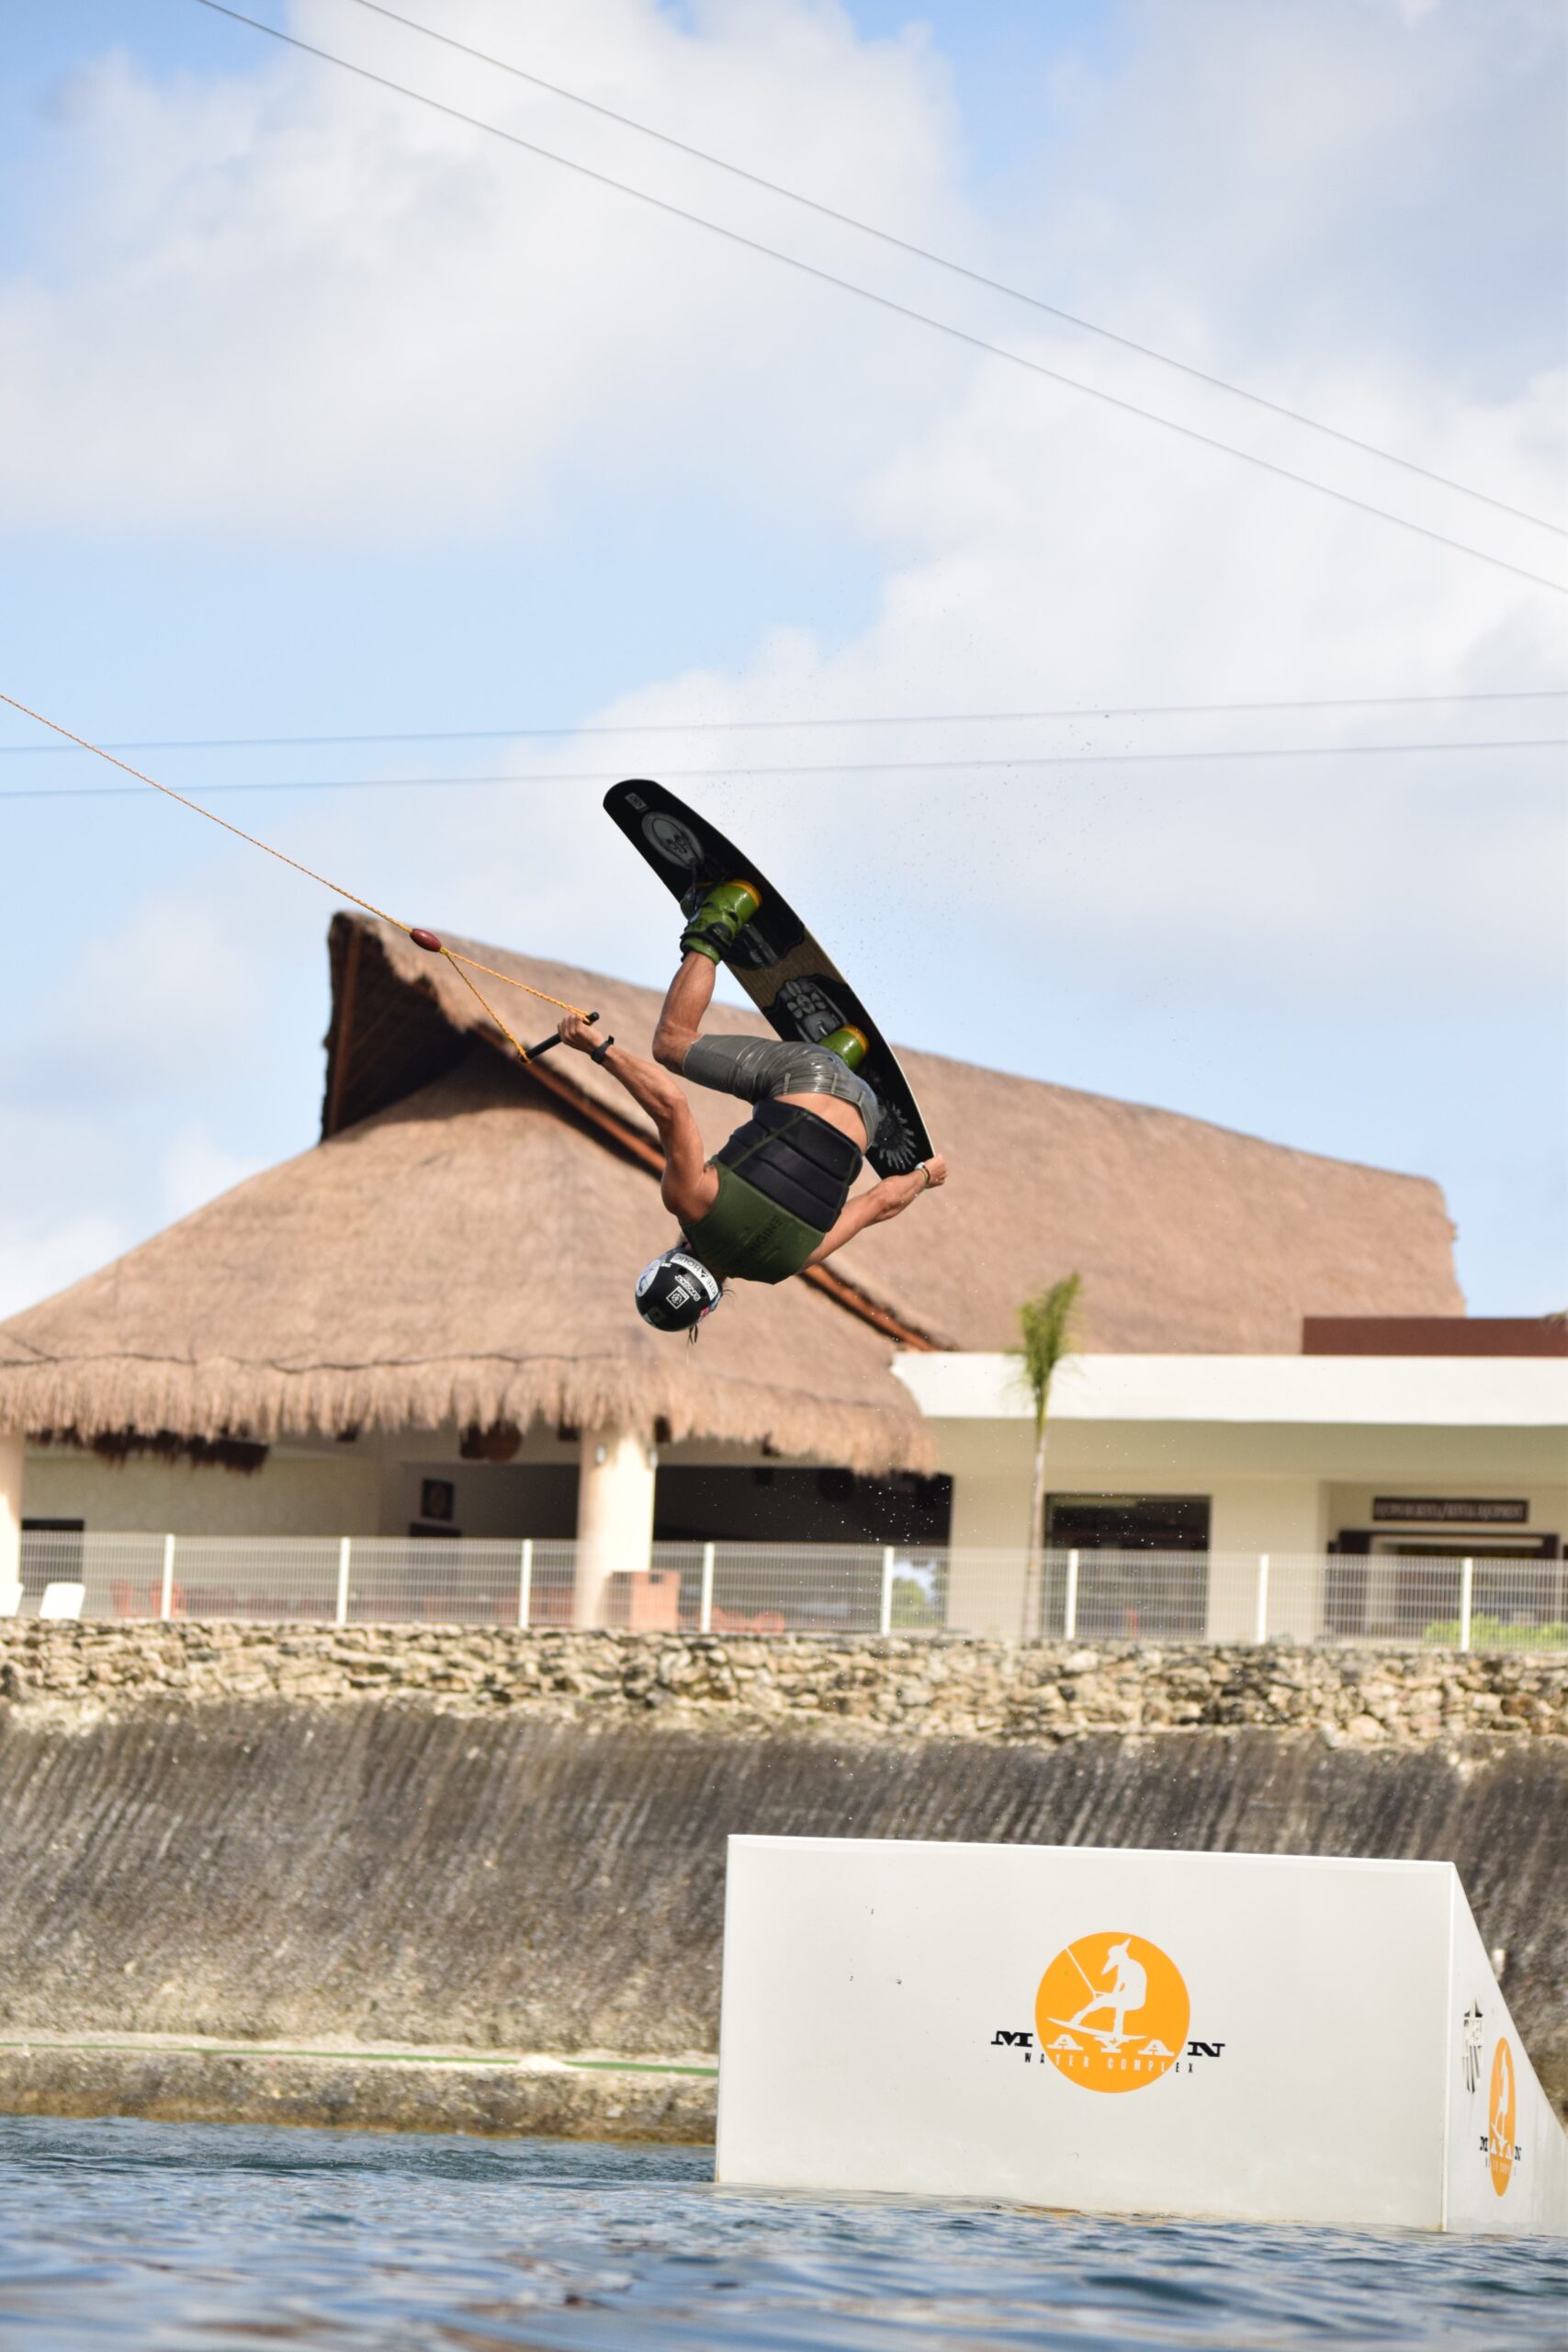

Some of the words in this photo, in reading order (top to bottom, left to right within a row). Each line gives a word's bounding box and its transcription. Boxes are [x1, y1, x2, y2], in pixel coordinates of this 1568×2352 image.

[990, 2030, 1226, 2058] MAYAN
[1024, 2052, 1090, 2068] WATER
[1107, 2057, 1194, 2074] COMPLEX
